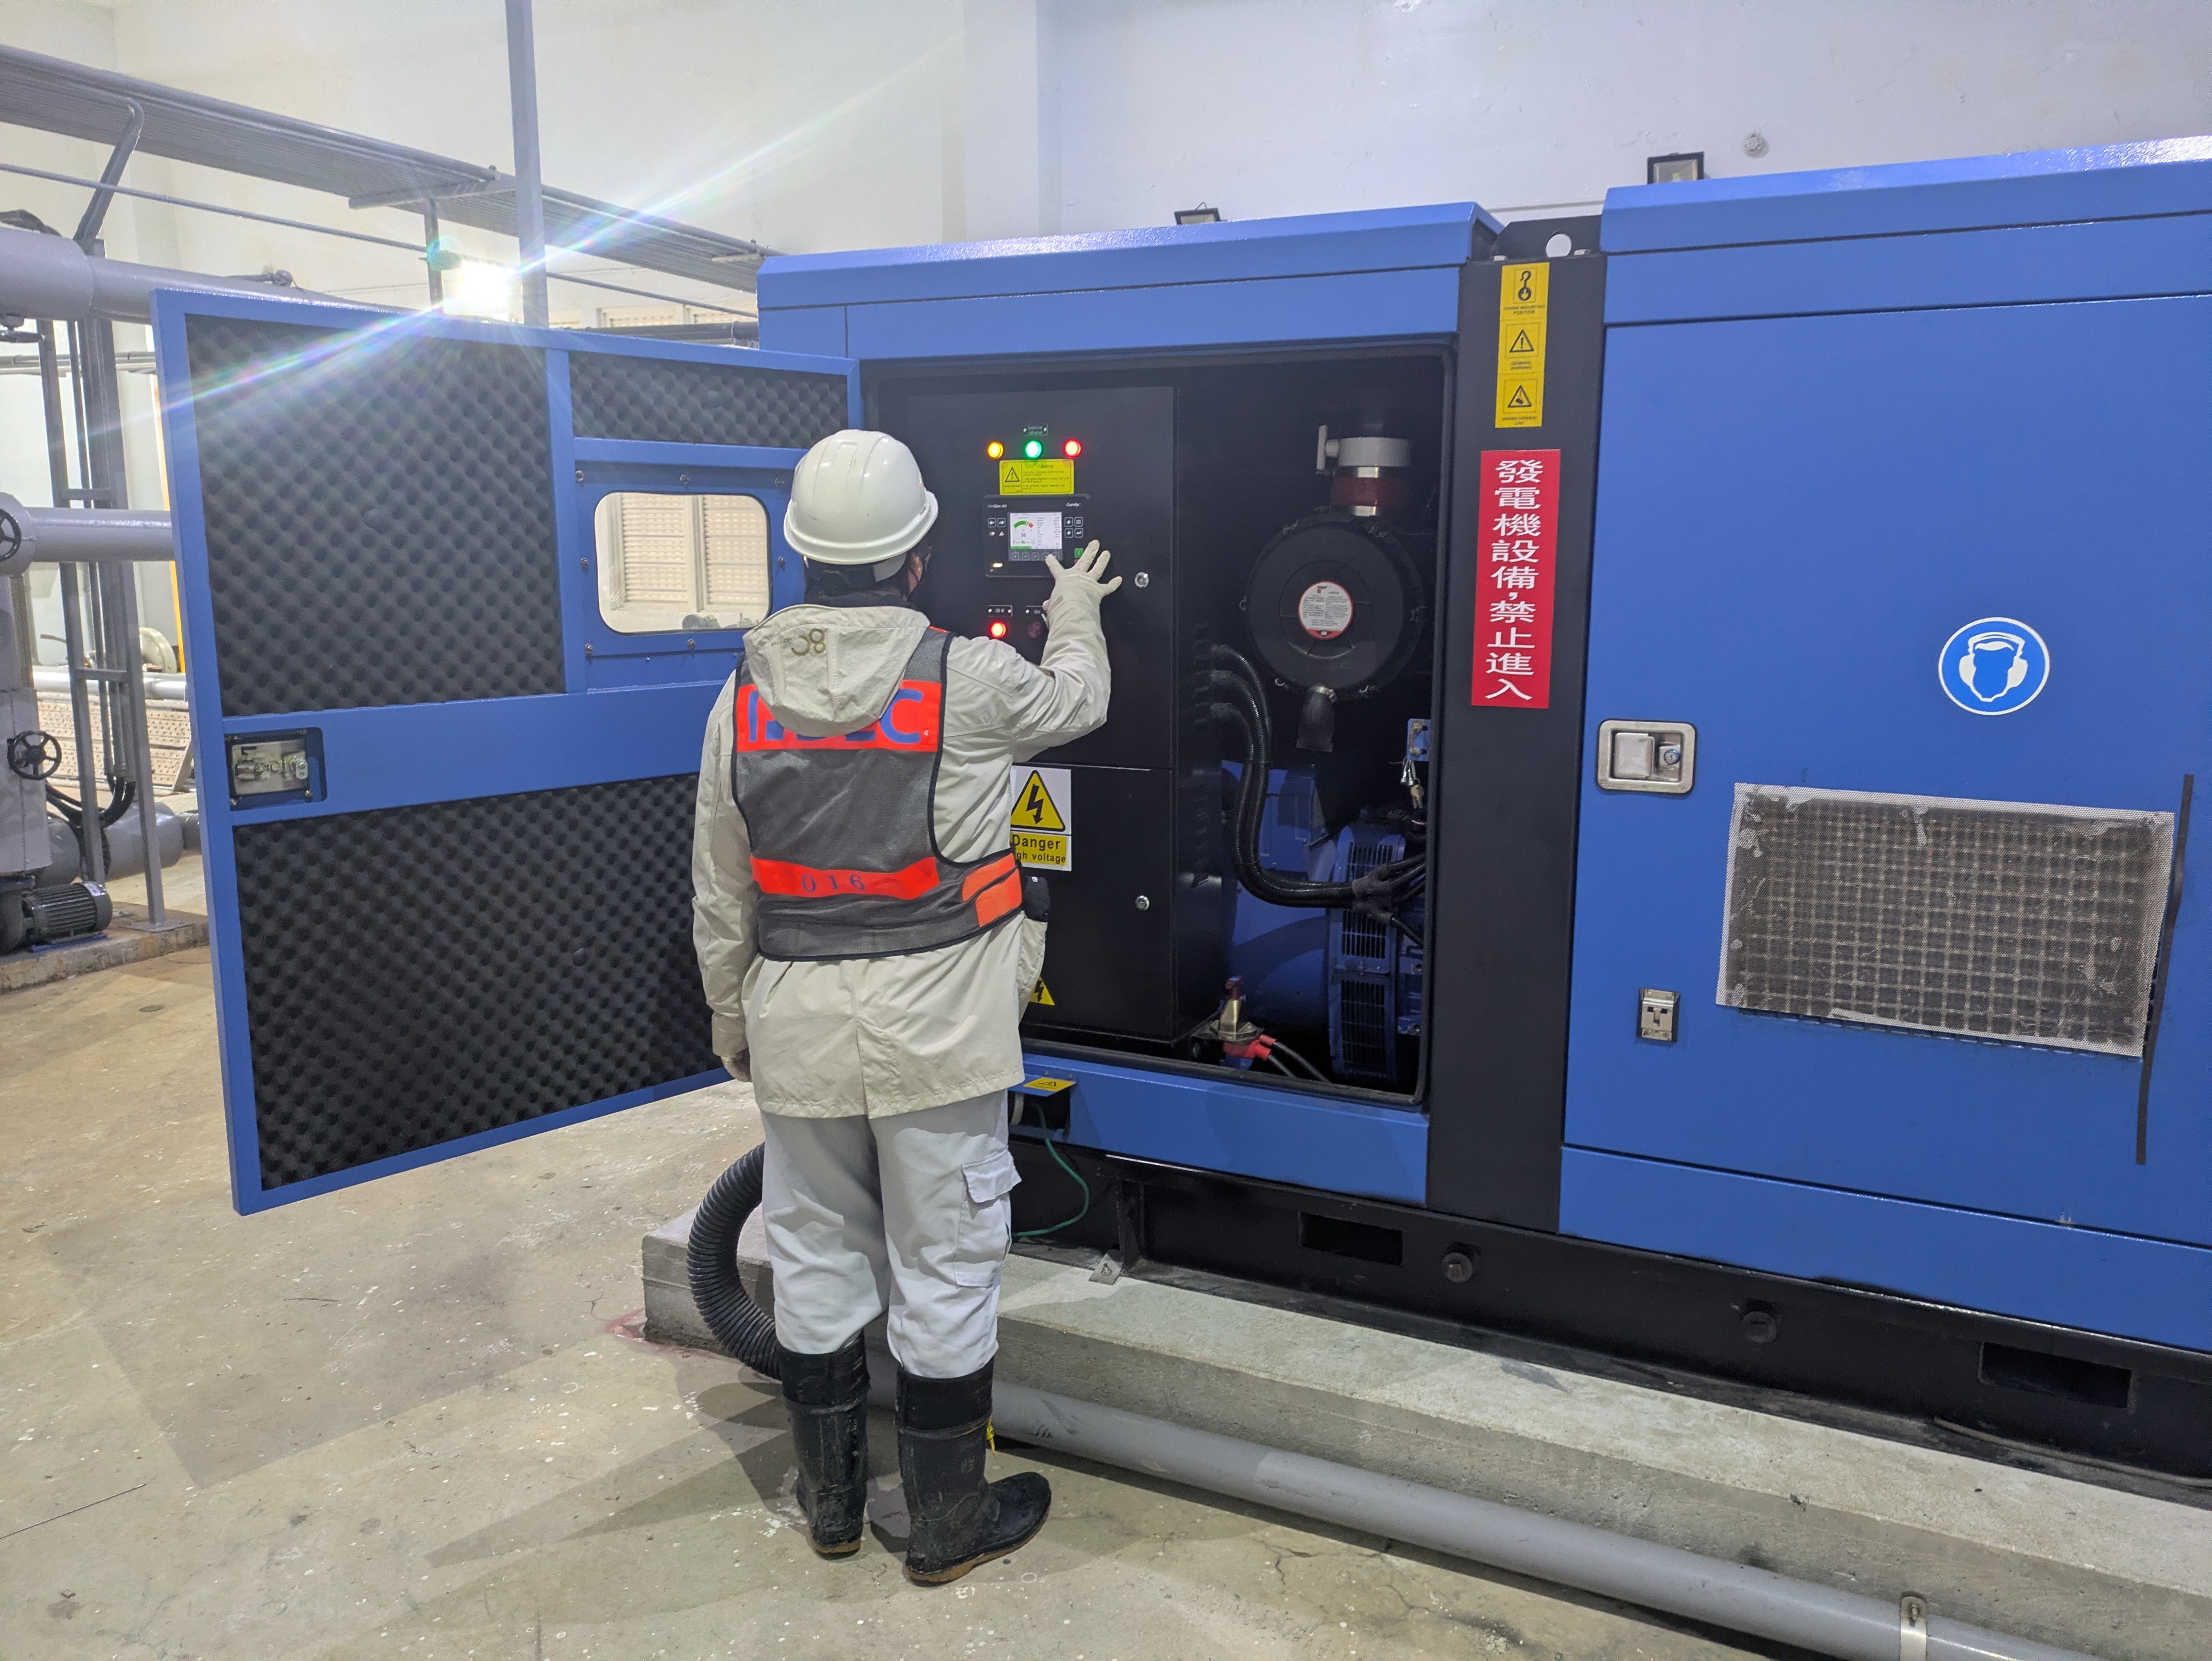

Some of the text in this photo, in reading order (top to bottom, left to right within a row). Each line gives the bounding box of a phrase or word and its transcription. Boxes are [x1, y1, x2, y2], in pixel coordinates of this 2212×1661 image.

[1012, 834, 1061, 852] Danger
[1032, 853, 1066, 864] voltage
[802, 873, 865, 892] 016
